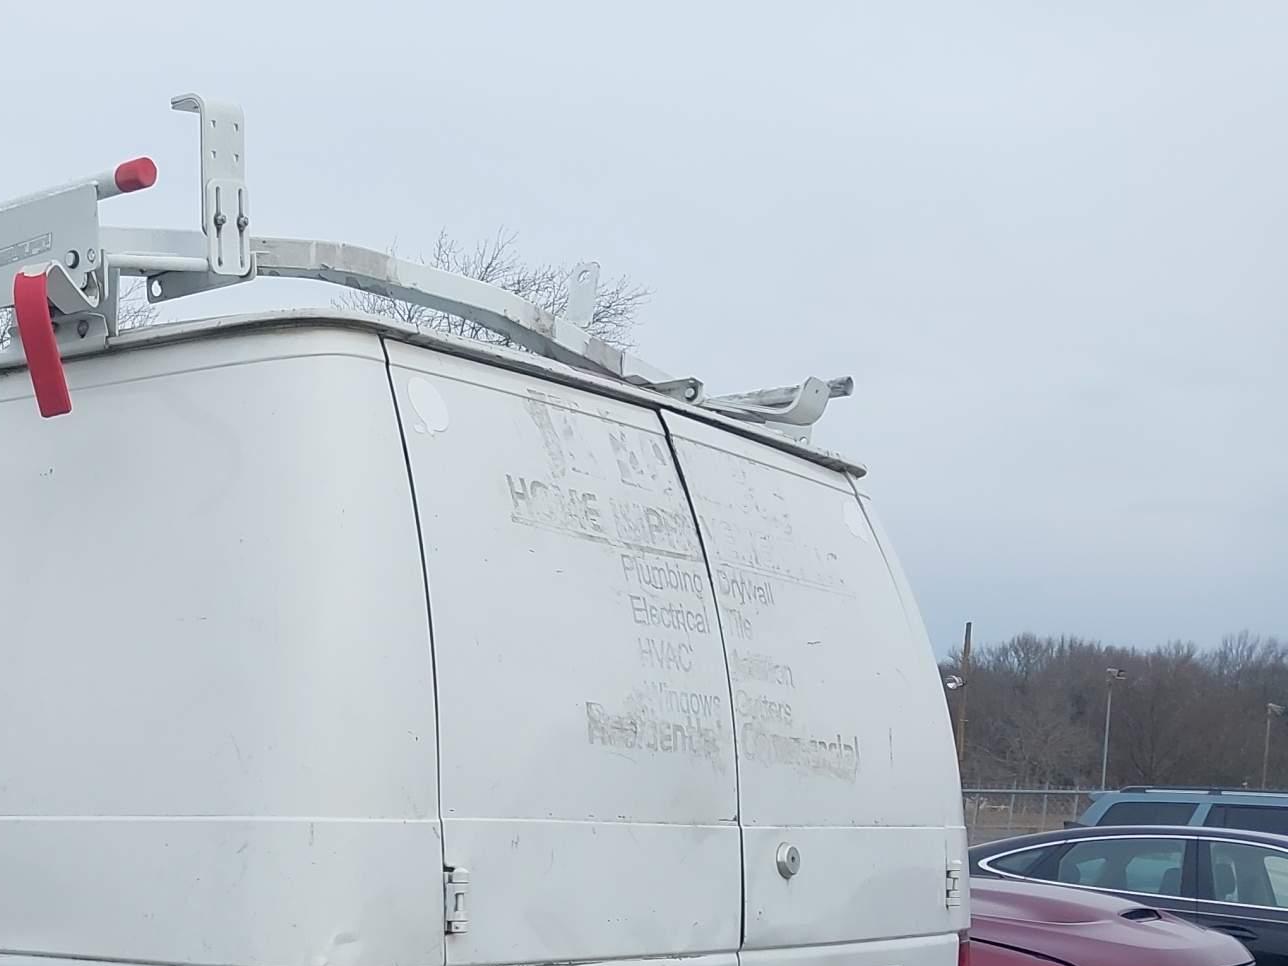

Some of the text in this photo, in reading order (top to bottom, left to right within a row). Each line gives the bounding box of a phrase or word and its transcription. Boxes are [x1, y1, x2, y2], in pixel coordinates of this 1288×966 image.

[620, 553, 704, 600] Plumbing
[629, 594, 711, 634] Electrical
[637, 638, 694, 673] HVAC
